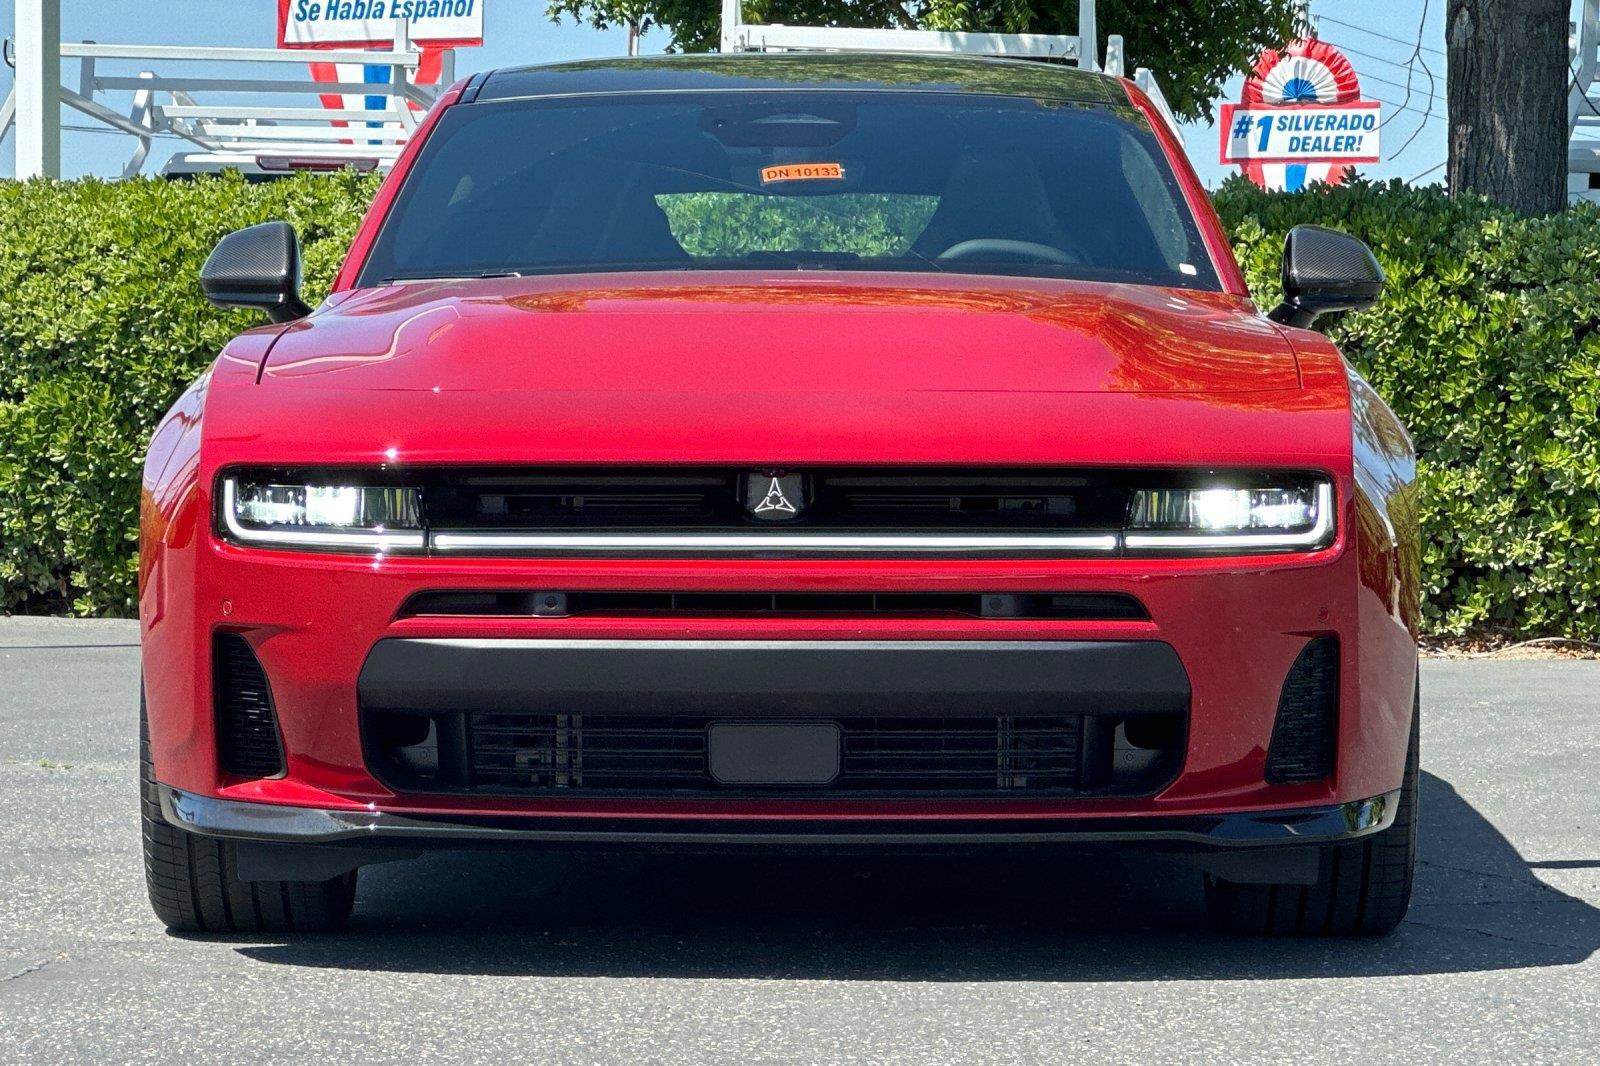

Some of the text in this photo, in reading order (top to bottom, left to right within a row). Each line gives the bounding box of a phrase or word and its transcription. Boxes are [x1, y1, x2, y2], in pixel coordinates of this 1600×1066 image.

[295, 0, 321, 22] Se
[325, 0, 385, 21] Habla
[1233, 114, 1375, 152] #1 SILVERADO
[1288, 135, 1363, 153] DEALER!
[766, 167, 839, 180] DN 10133
